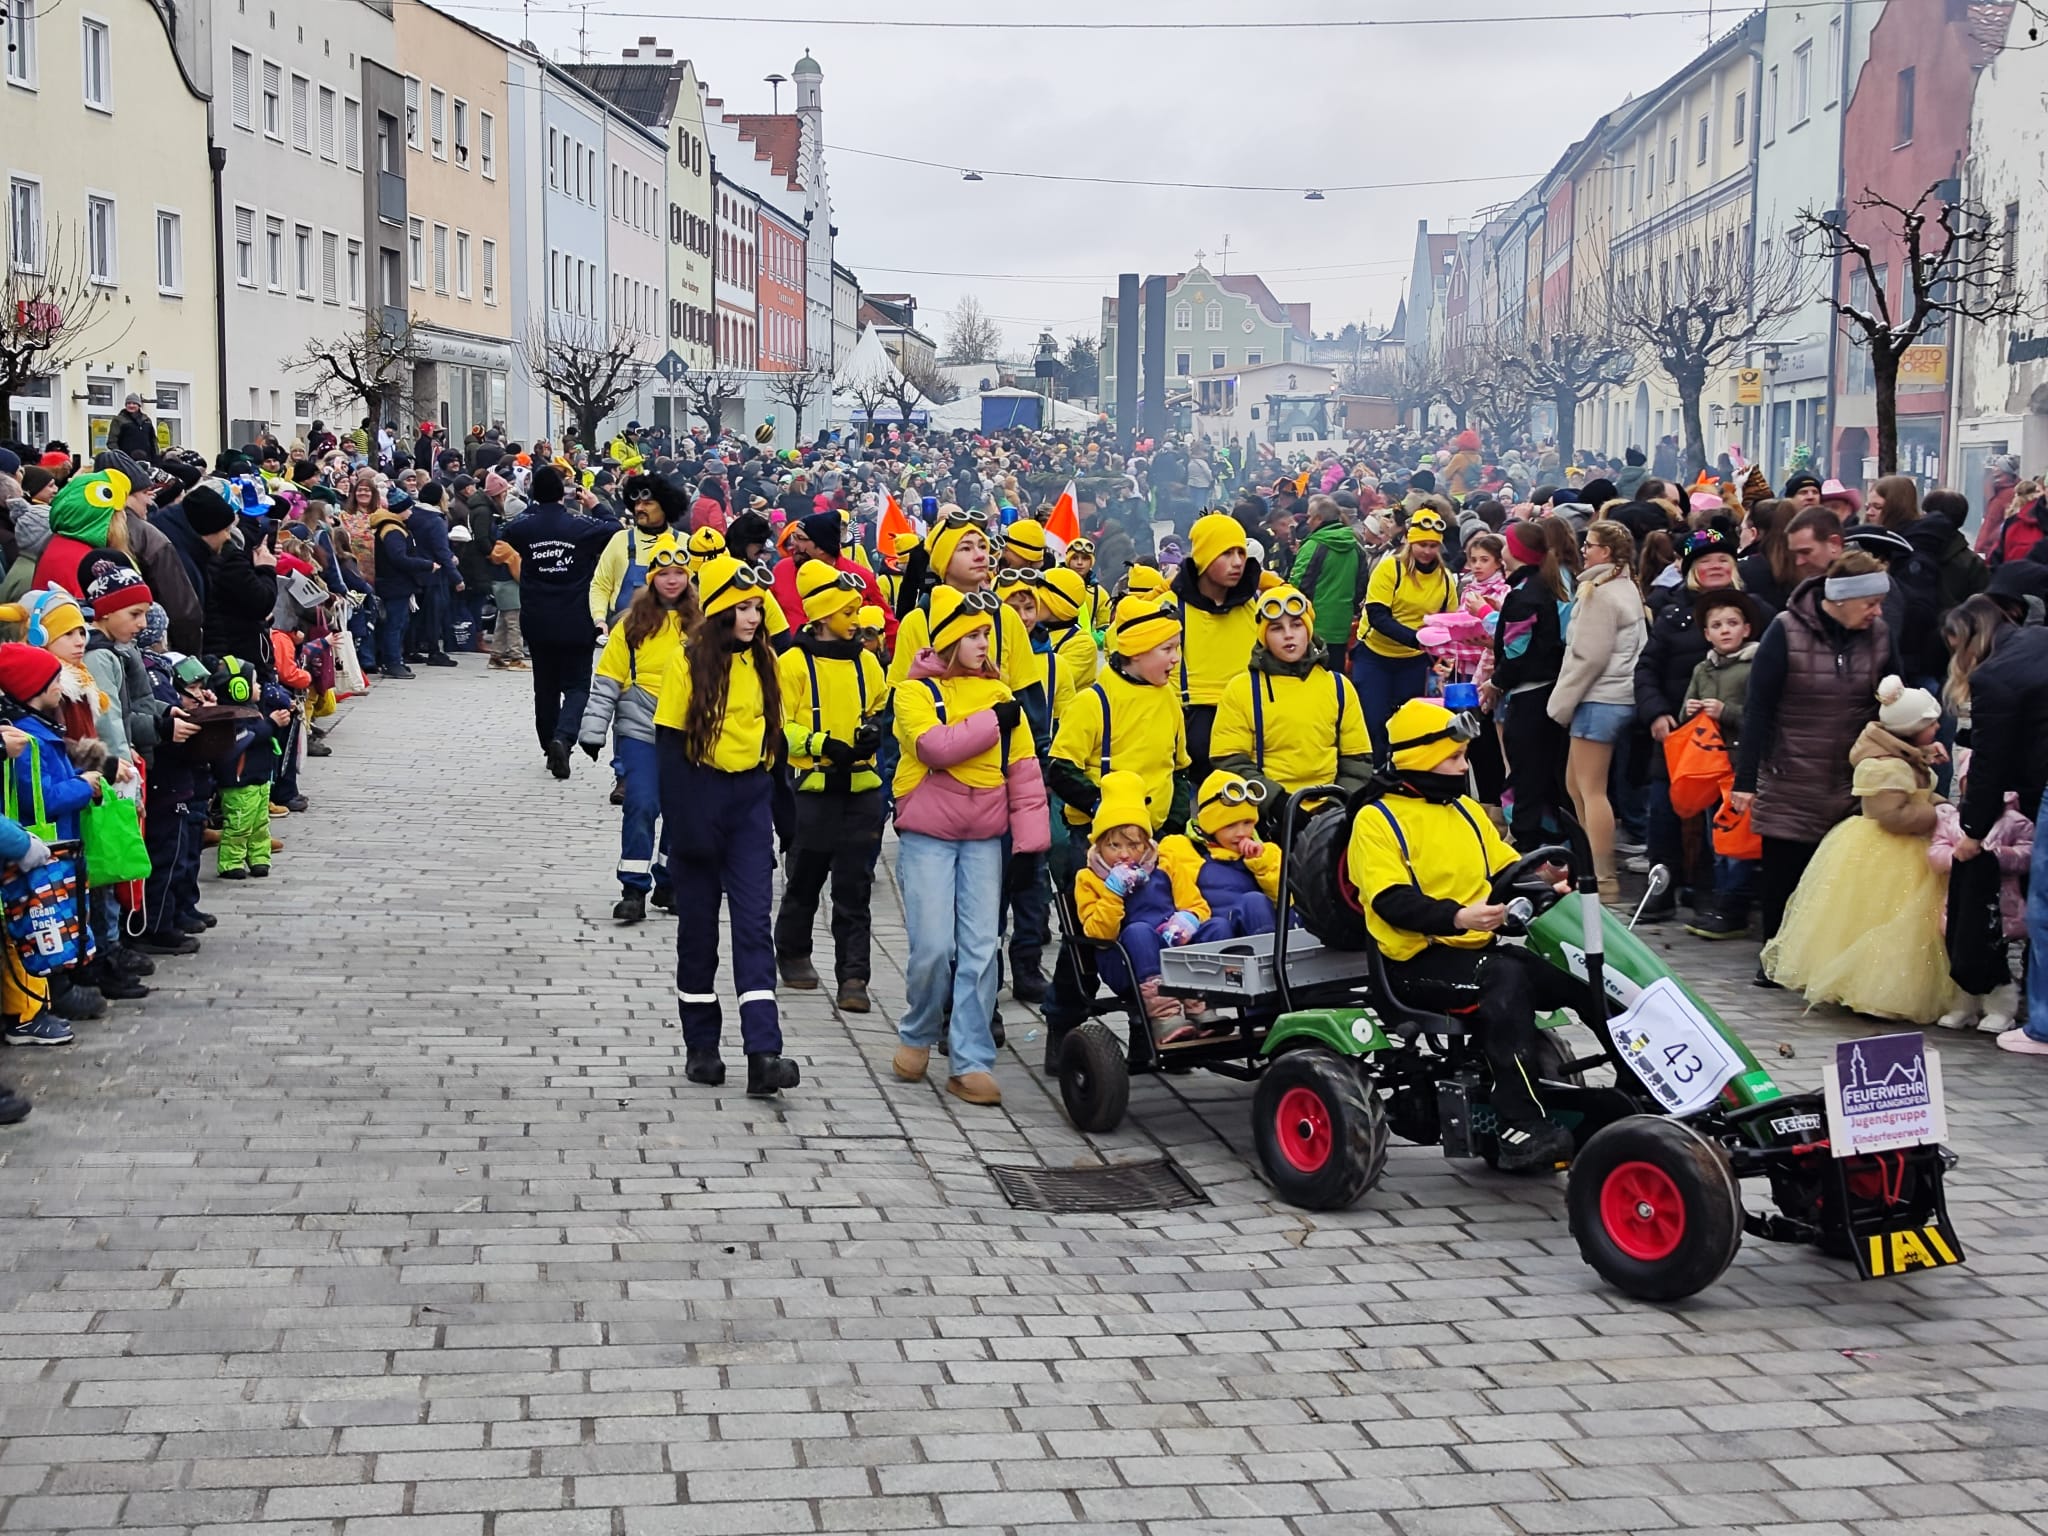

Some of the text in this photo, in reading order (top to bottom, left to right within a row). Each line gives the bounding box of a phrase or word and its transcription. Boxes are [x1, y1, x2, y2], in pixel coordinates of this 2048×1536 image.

[1904, 349, 1942, 361] HOTO
[532, 548, 564, 560] Society
[42, 931, 55, 952] 5
[1573, 953, 1624, 996] roter
[1663, 1042, 1703, 1083] 43
[1845, 1081, 1925, 1105] FEUERWEHR
[1846, 1102, 1875, 1114] MARKT
[1851, 1109, 1927, 1128] Jugendgruppe
[1852, 1126, 1930, 1145] Kinderfeuerwehr
